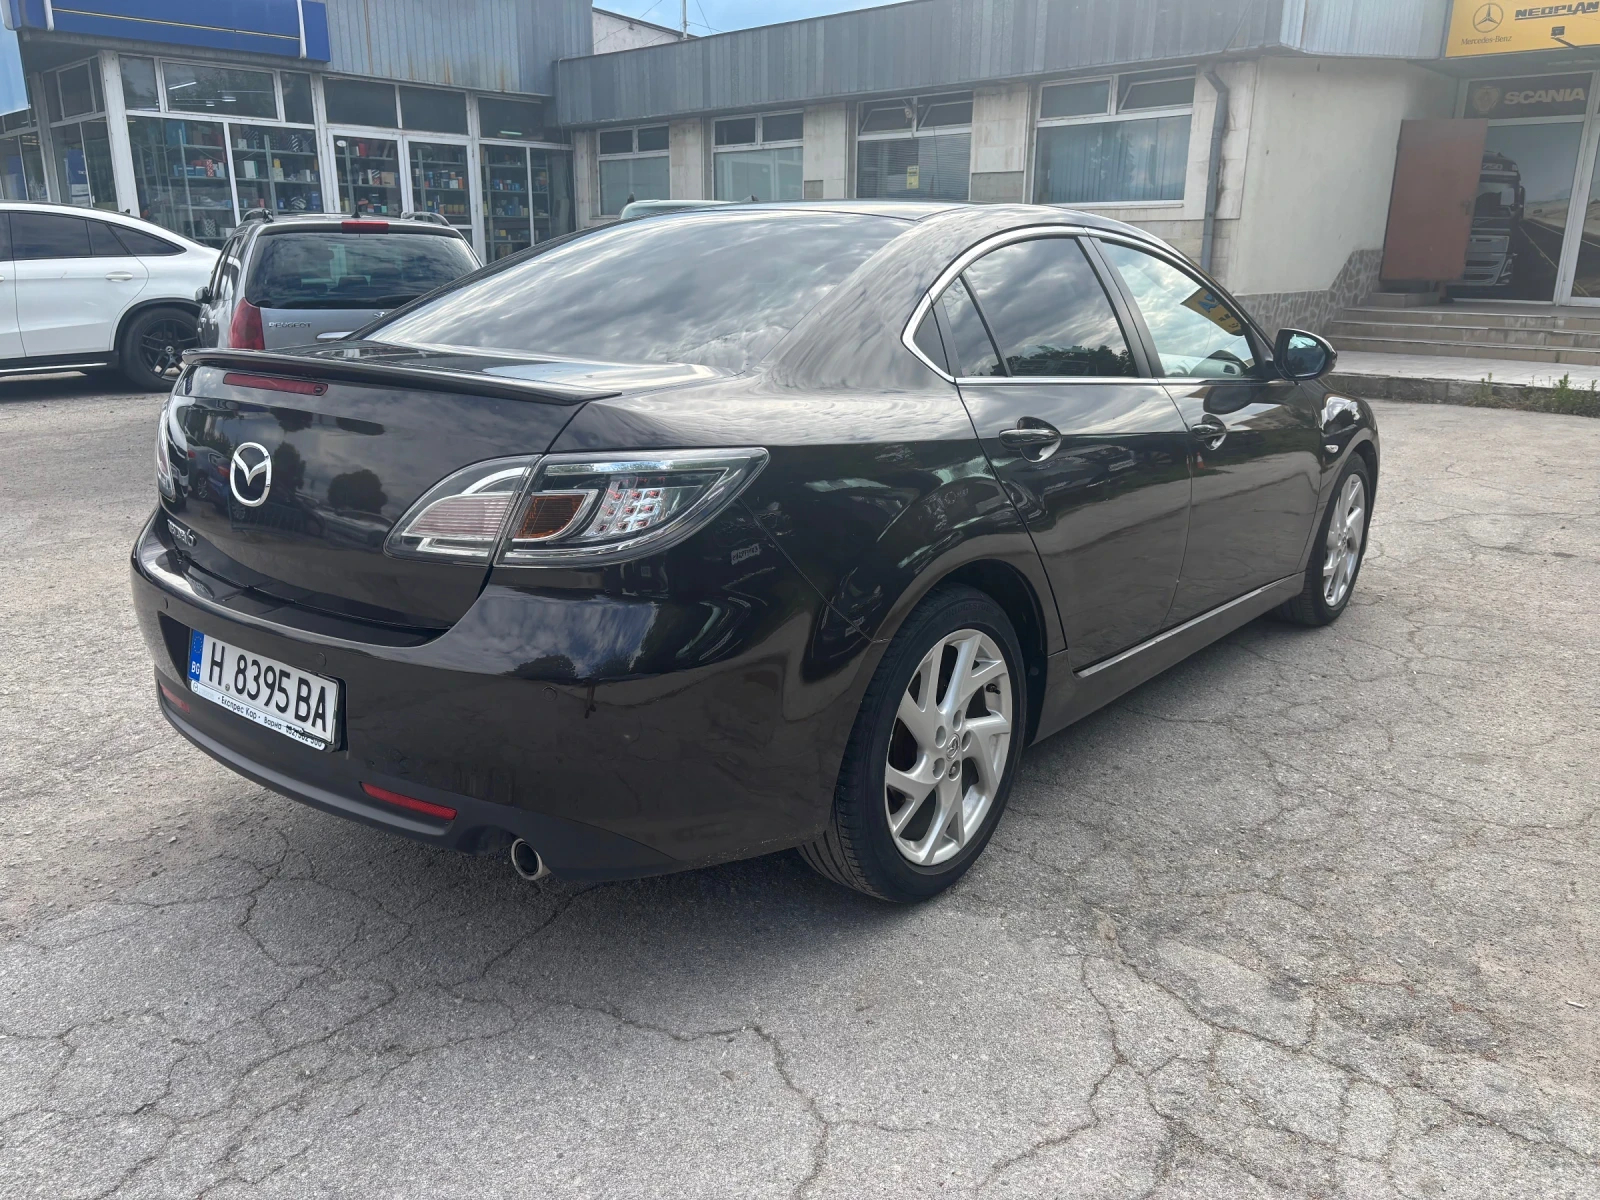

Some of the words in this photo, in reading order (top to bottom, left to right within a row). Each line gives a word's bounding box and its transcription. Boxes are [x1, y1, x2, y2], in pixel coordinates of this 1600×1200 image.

[1514, 1, 1600, 18] NEOPLAN
[1460, 35, 1513, 46] Mercedes-Benz
[1503, 87, 1586, 105] SCANIA
[268, 321, 312, 329] PEUGEOT
[191, 660, 201, 675] BG
[264, 716, 283, 730] Варна
